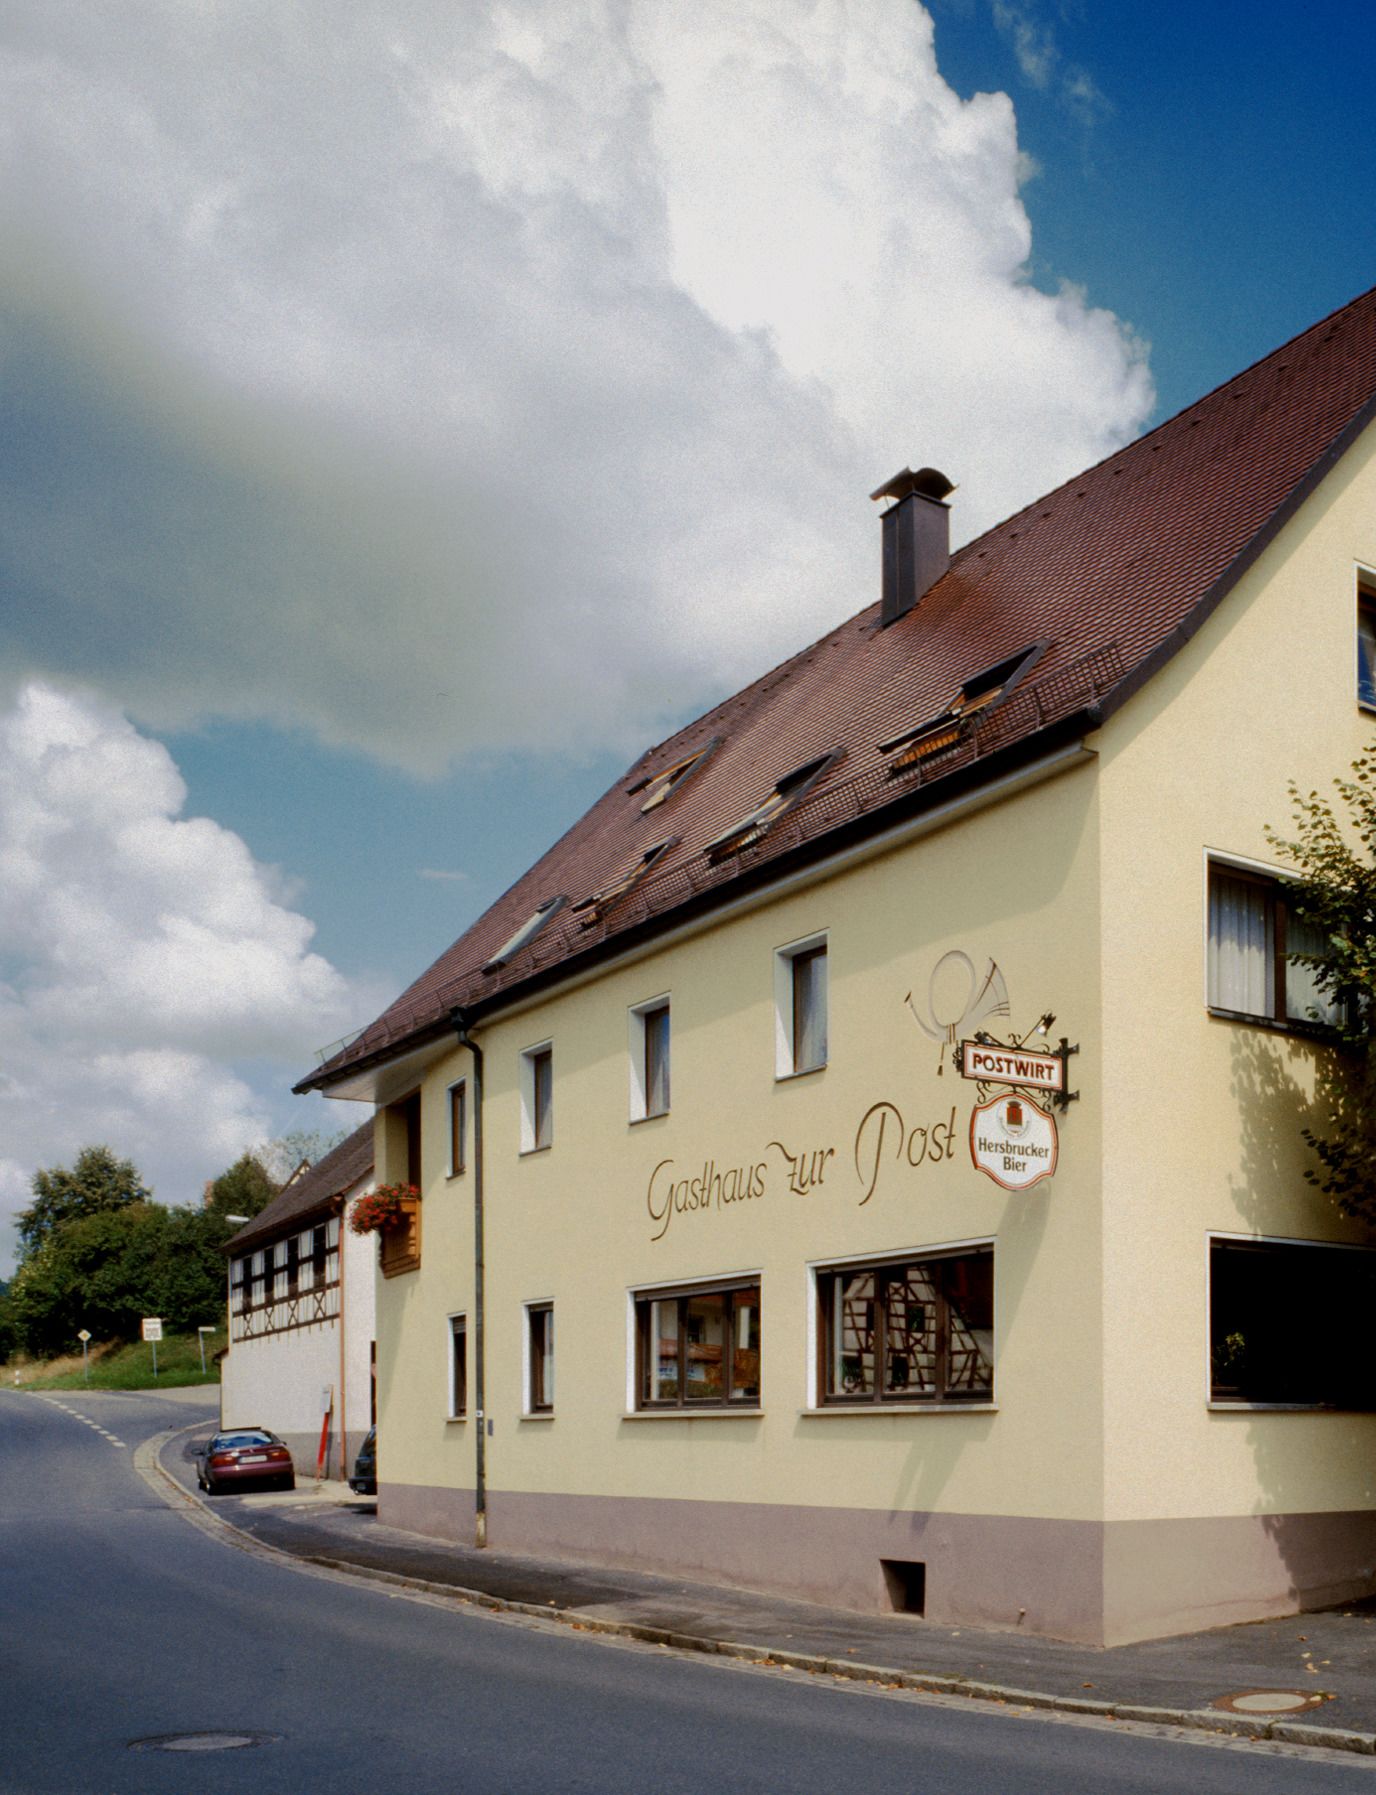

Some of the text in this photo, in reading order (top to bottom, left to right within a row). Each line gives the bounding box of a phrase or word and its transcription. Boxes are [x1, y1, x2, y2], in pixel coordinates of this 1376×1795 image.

[973, 1053, 1054, 1081] POSTWIRT
[978, 1137, 1049, 1158] Hersbrucker
[647, 1159, 767, 1241] Gasthaus
[855, 1101, 956, 1206] Post
[1003, 1156, 1026, 1172] Bier
